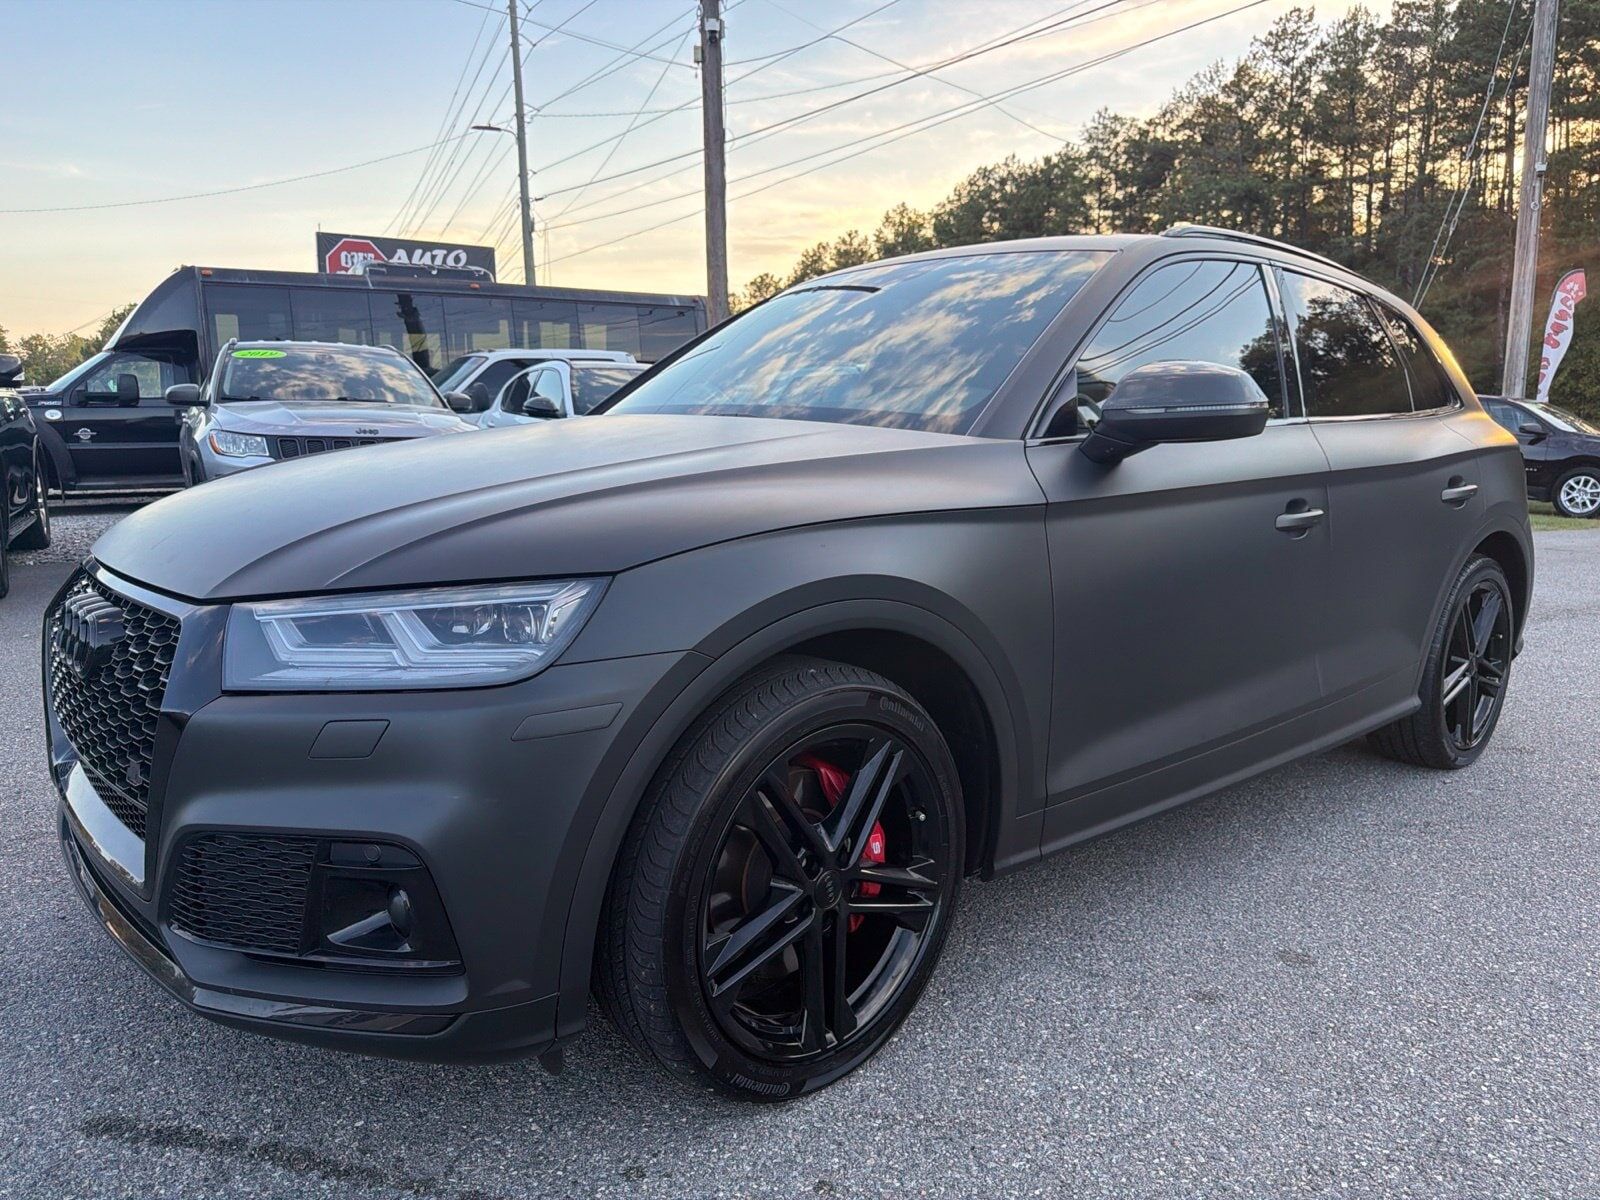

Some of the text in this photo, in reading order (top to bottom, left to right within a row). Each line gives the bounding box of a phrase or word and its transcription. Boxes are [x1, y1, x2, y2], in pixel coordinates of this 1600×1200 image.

[388, 248, 468, 267] AUTO
[355, 427, 379, 436] Jeep
[879, 695, 925, 732] Continental
[729, 1072, 791, 1097] Continental
